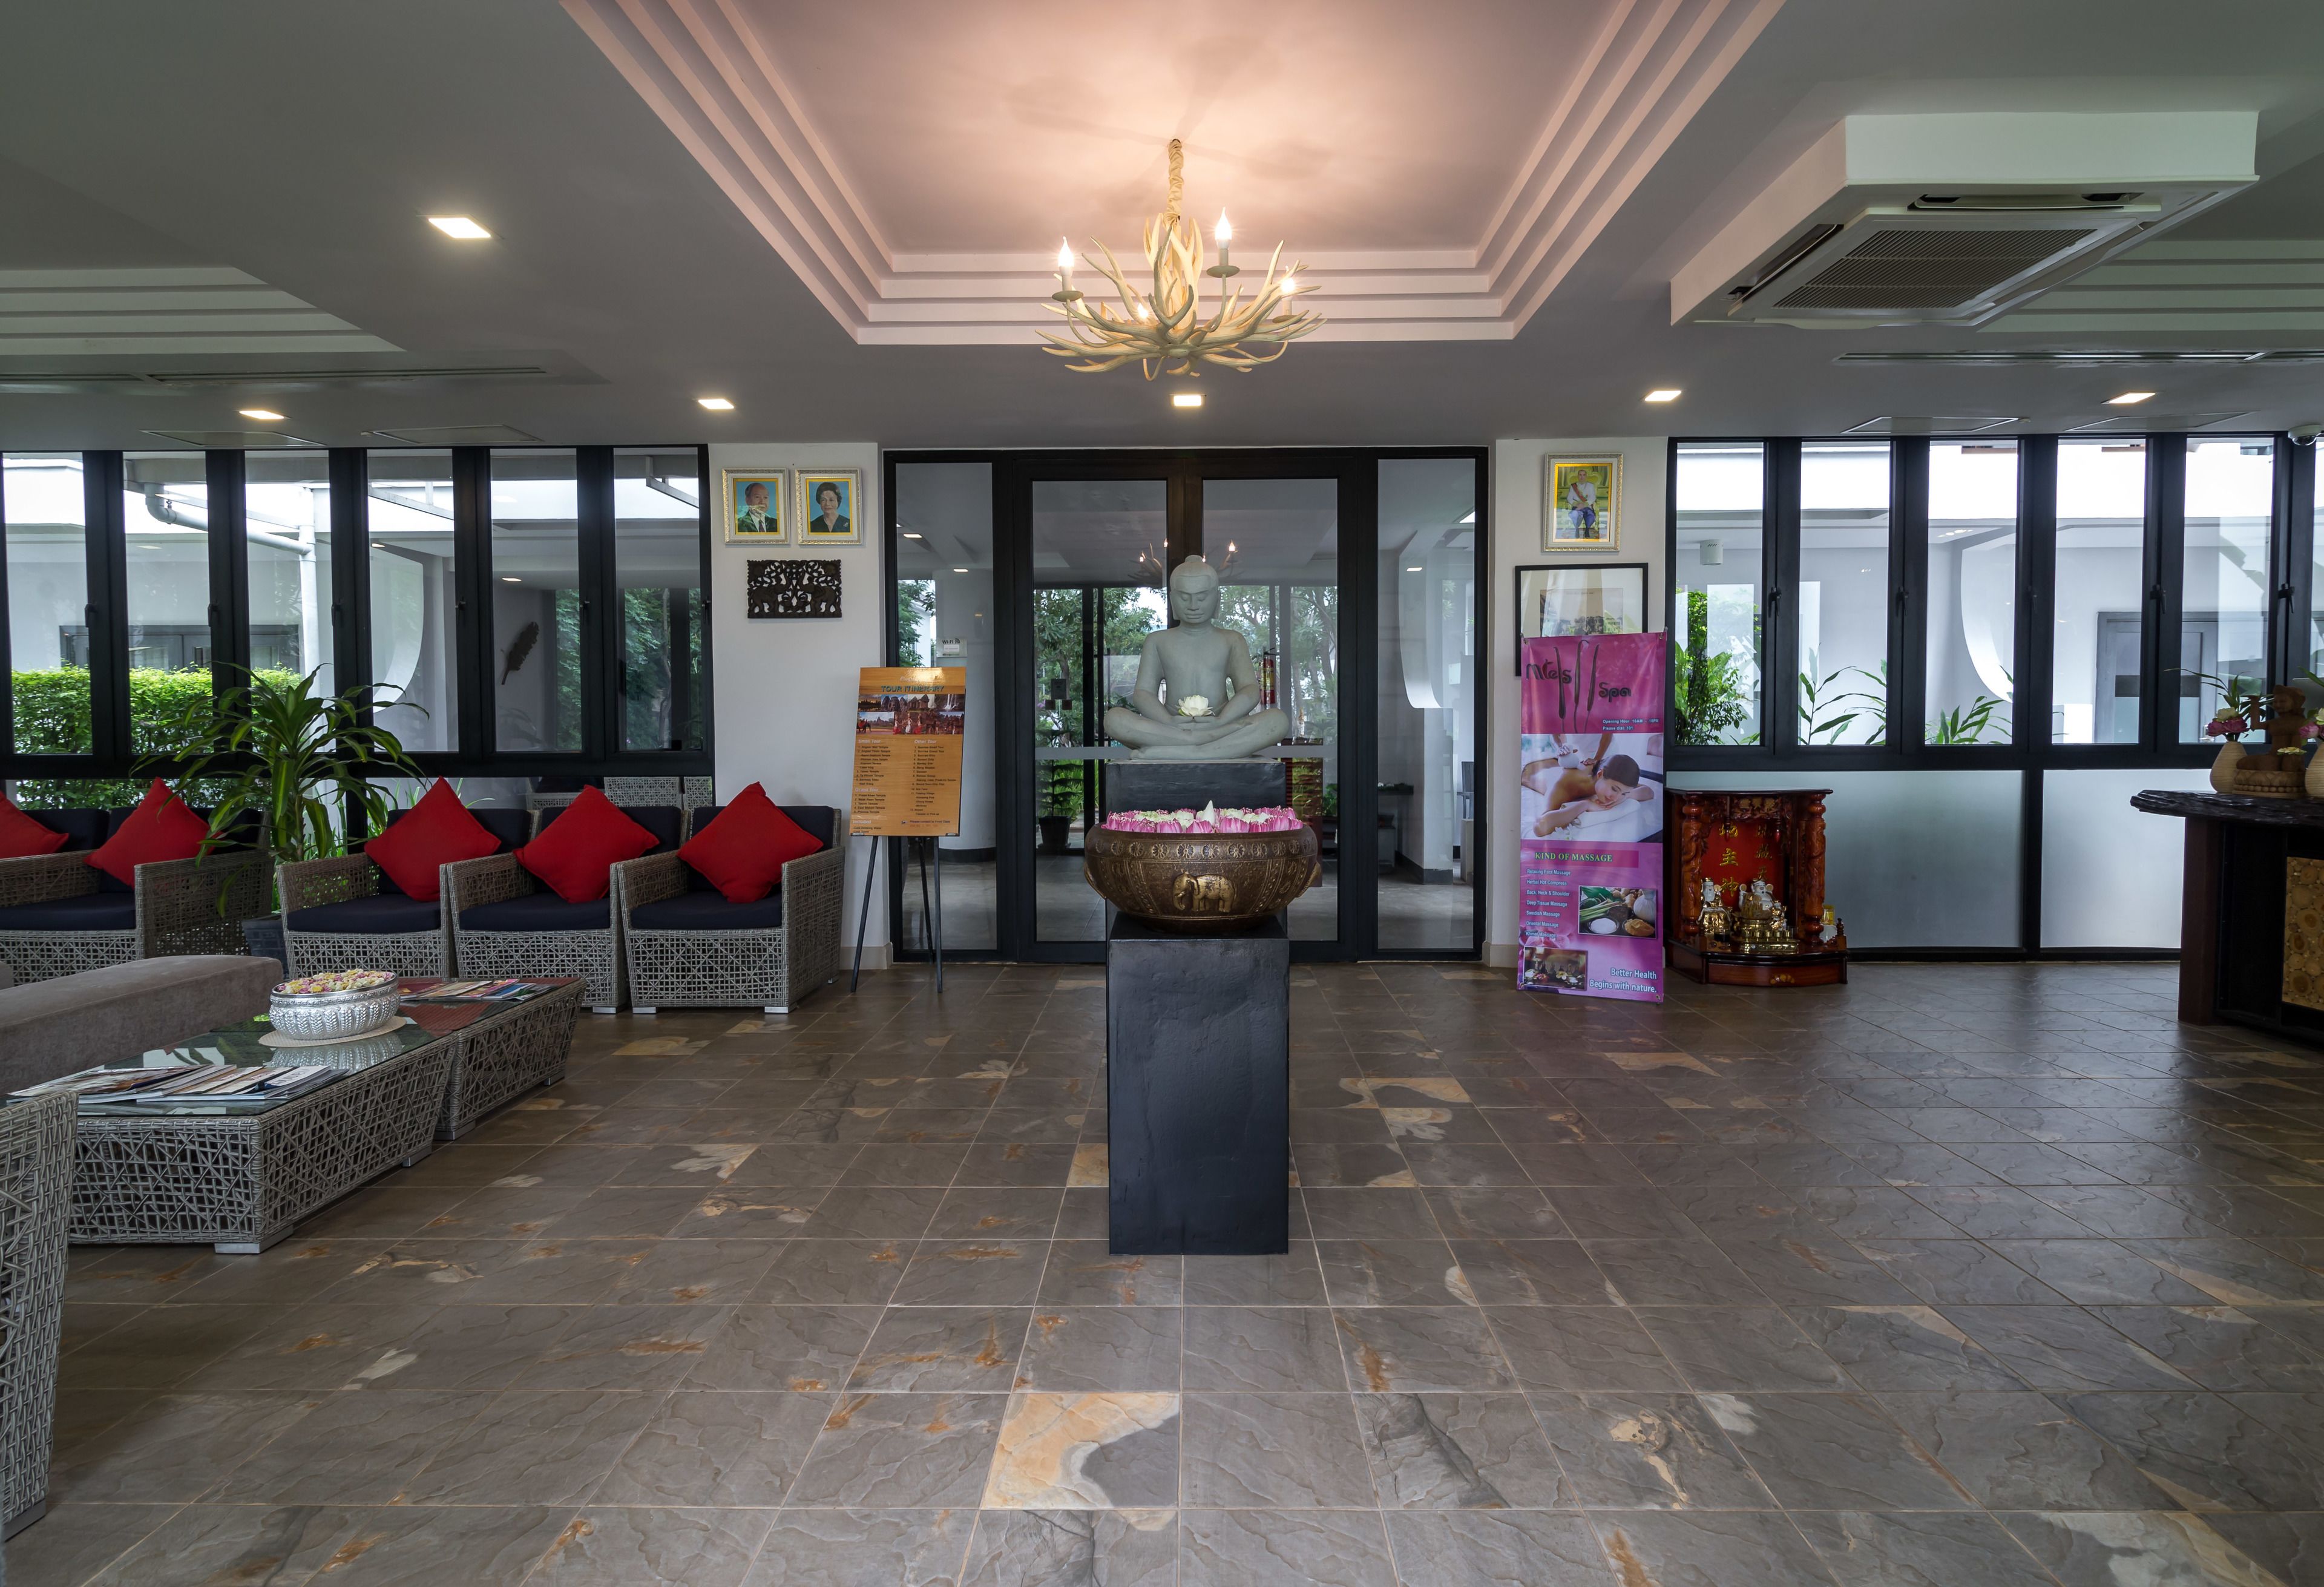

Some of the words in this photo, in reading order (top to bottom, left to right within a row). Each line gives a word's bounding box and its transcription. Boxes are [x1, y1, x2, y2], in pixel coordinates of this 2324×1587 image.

[1598, 682, 1632, 703] Spa
[1572, 853, 1612, 862] MASSAGE
[1611, 968, 1632, 978] Better
[1634, 970, 1657, 979] Health
[1589, 979, 1613, 990] Begins
[1614, 982, 1630, 990] with
[1632, 984, 1657, 993] nature.
